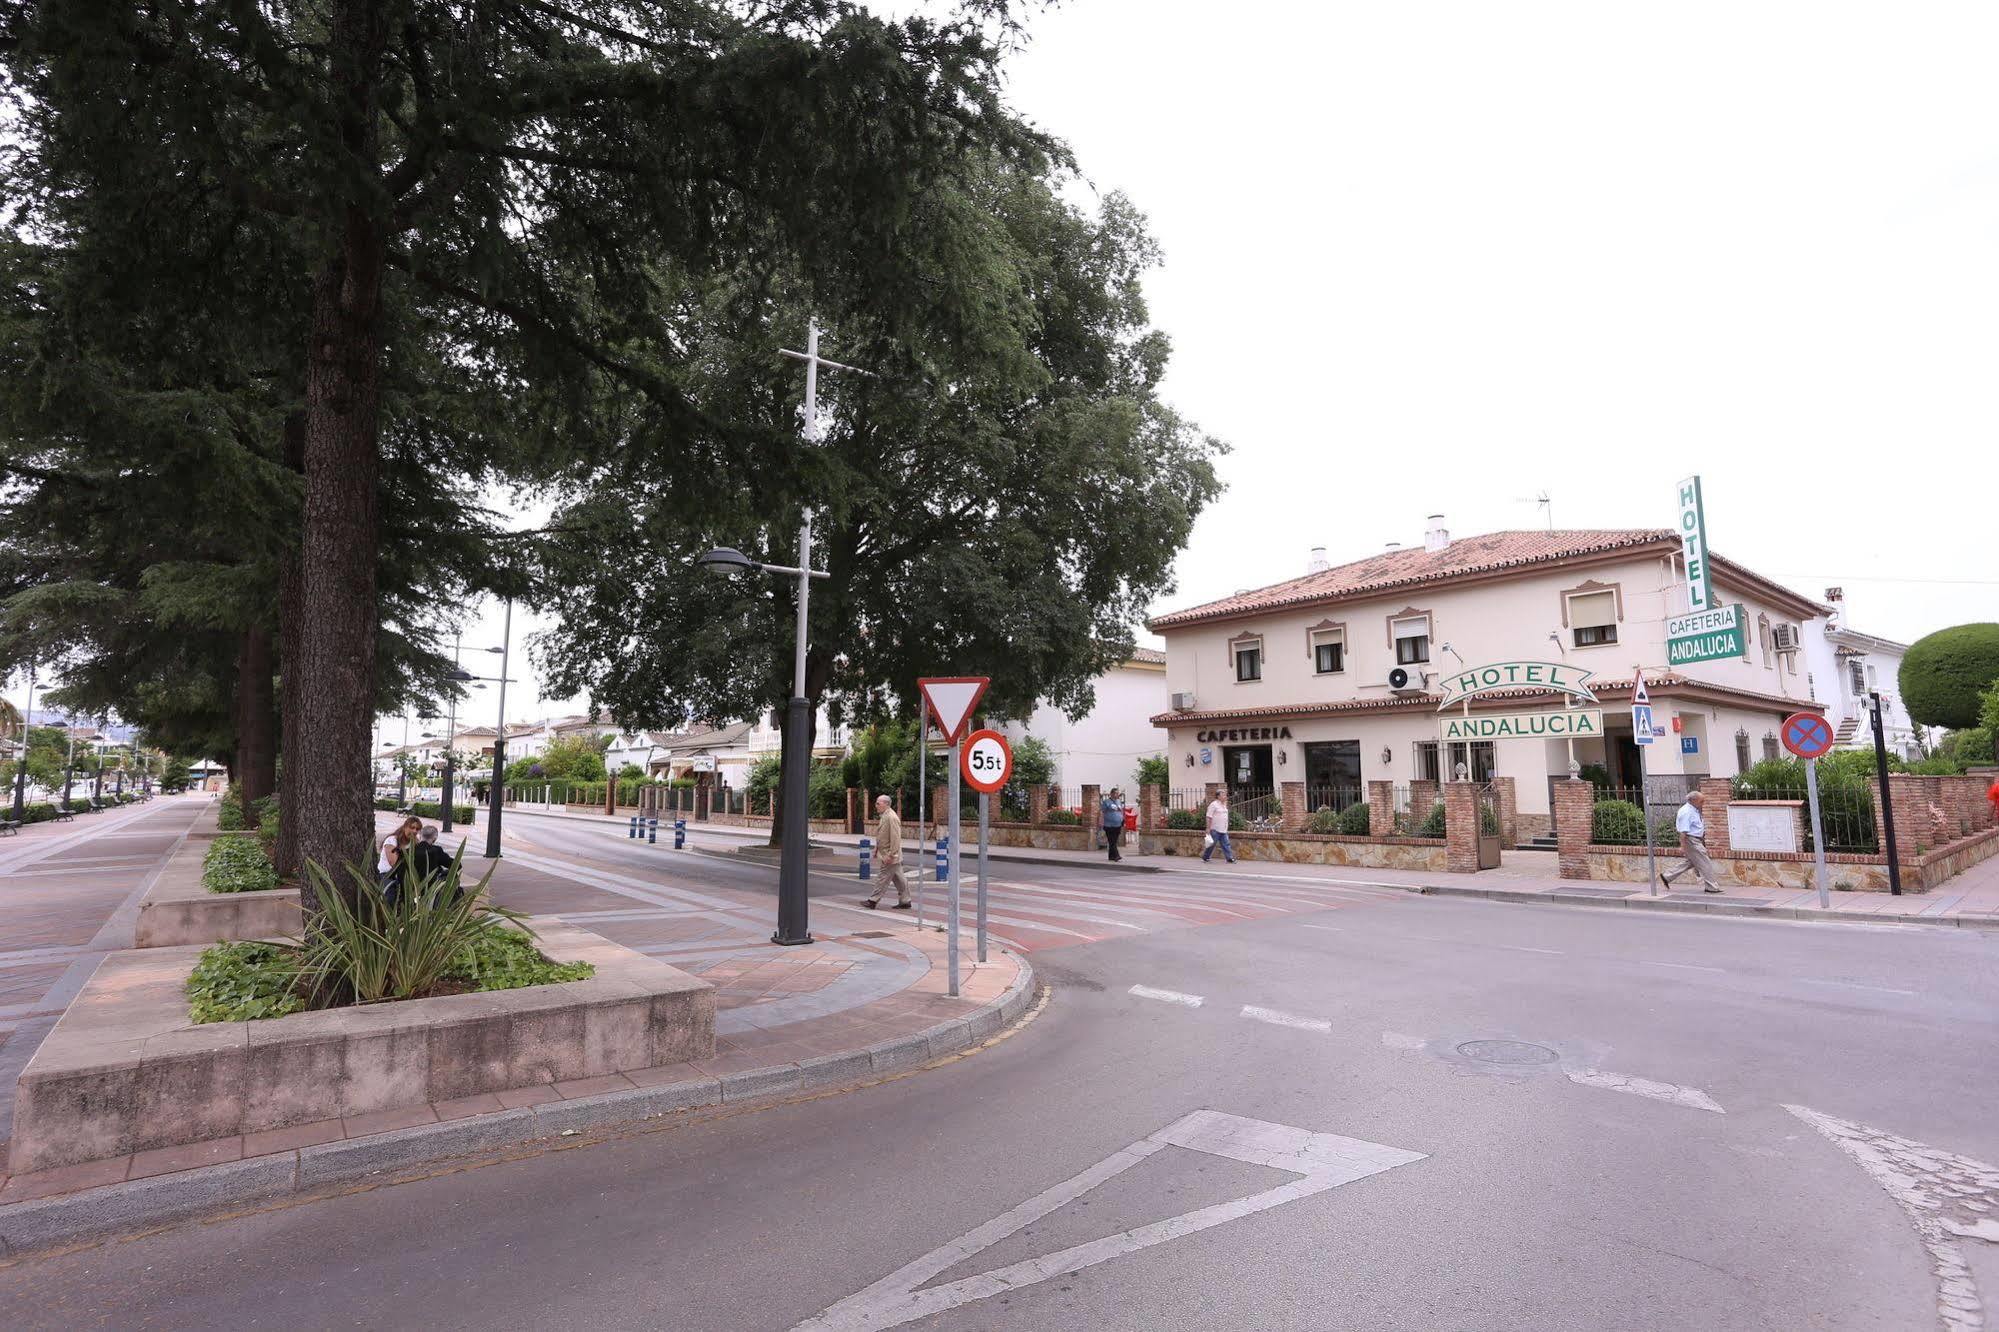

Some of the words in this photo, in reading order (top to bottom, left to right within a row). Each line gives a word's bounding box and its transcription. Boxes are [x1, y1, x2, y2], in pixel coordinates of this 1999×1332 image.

[1680, 485, 1703, 606] HOTEL
[1670, 610, 1734, 635] CAFETERIA
[1671, 633, 1737, 661] ANDALUCIA
[1459, 665, 1566, 692] HOTEL
[1197, 726, 1292, 743] CAFETERIA
[1447, 714, 1594, 738] ANDALUCIA
